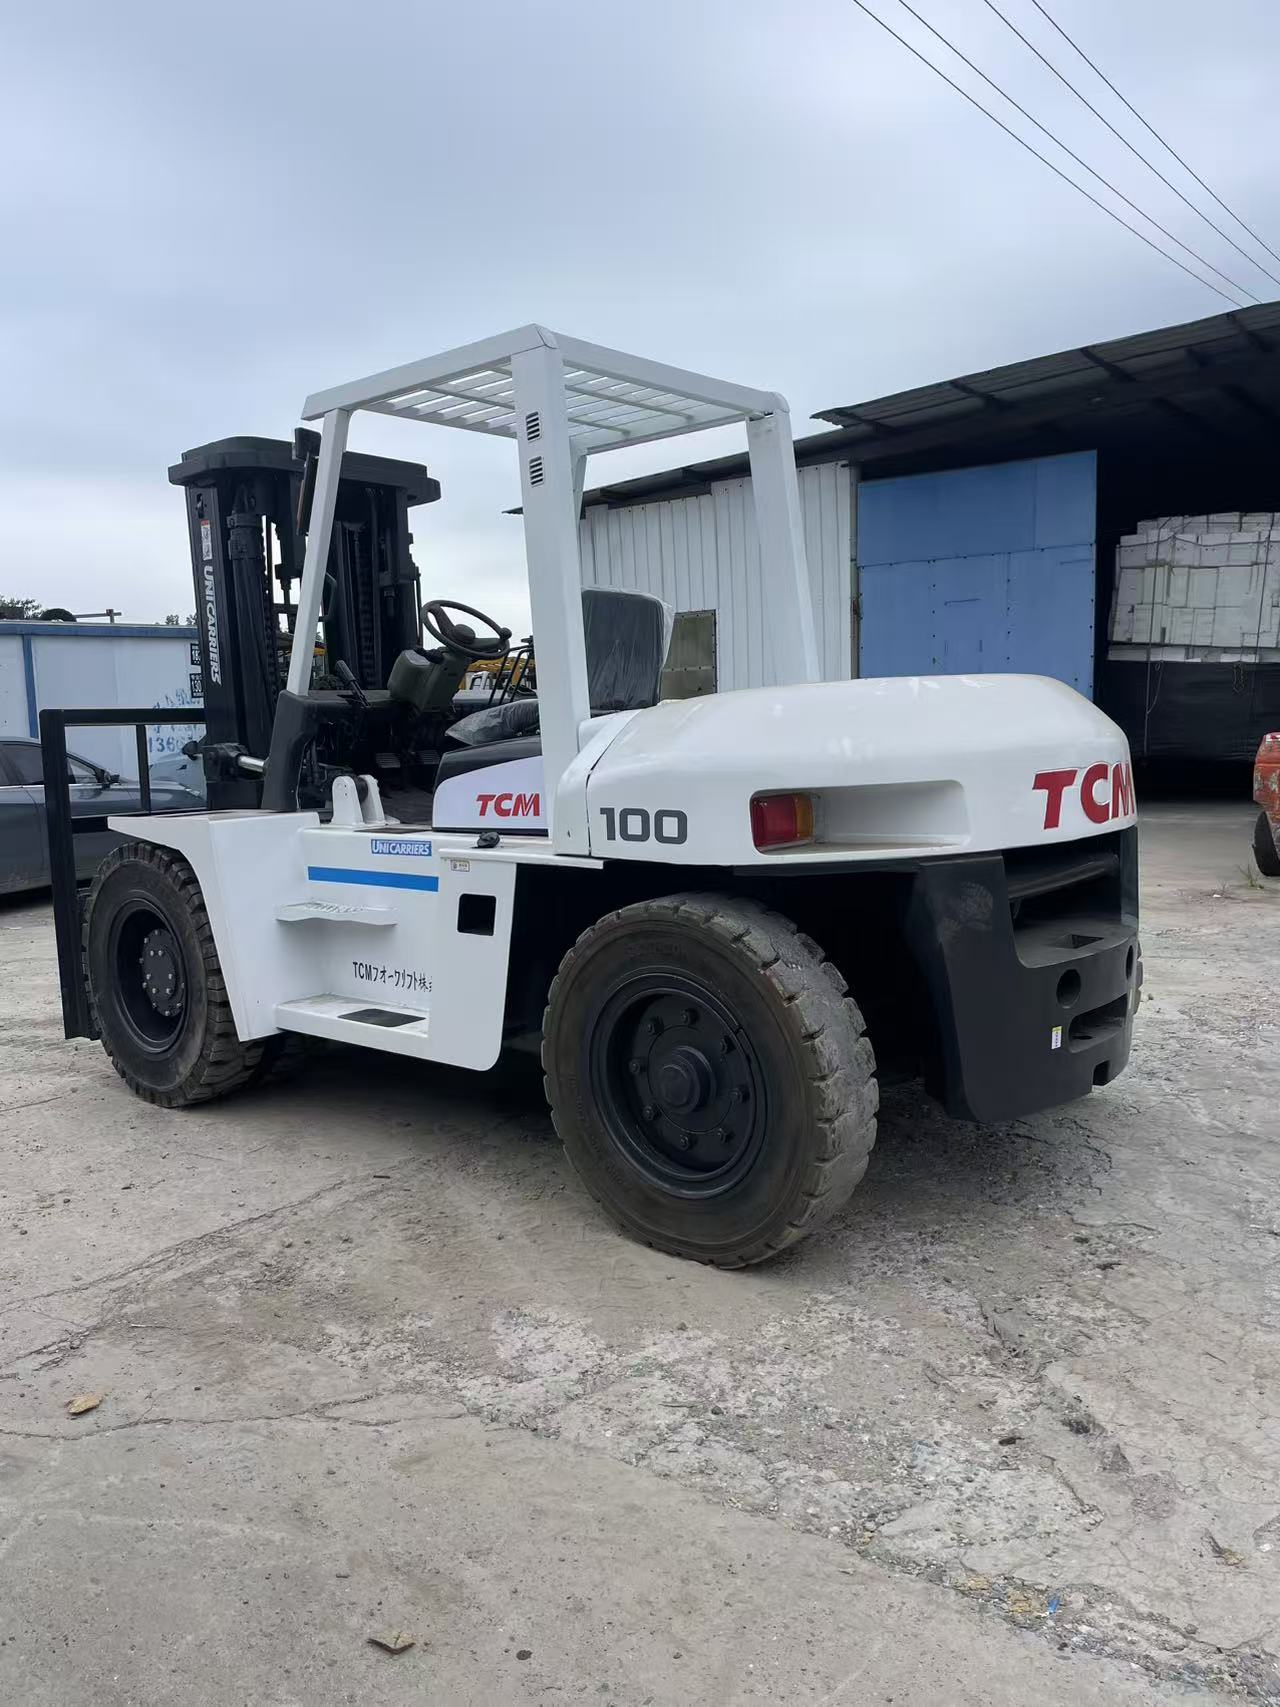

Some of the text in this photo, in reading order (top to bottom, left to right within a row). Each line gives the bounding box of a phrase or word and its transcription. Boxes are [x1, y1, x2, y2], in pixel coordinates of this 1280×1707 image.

[204, 565, 222, 686] UNICARRIERS
[477, 793, 541, 817] TCM
[1032, 762, 1135, 829] TCM
[600, 807, 688, 845] 100
[372, 839, 430, 855] UNICARRIERS
